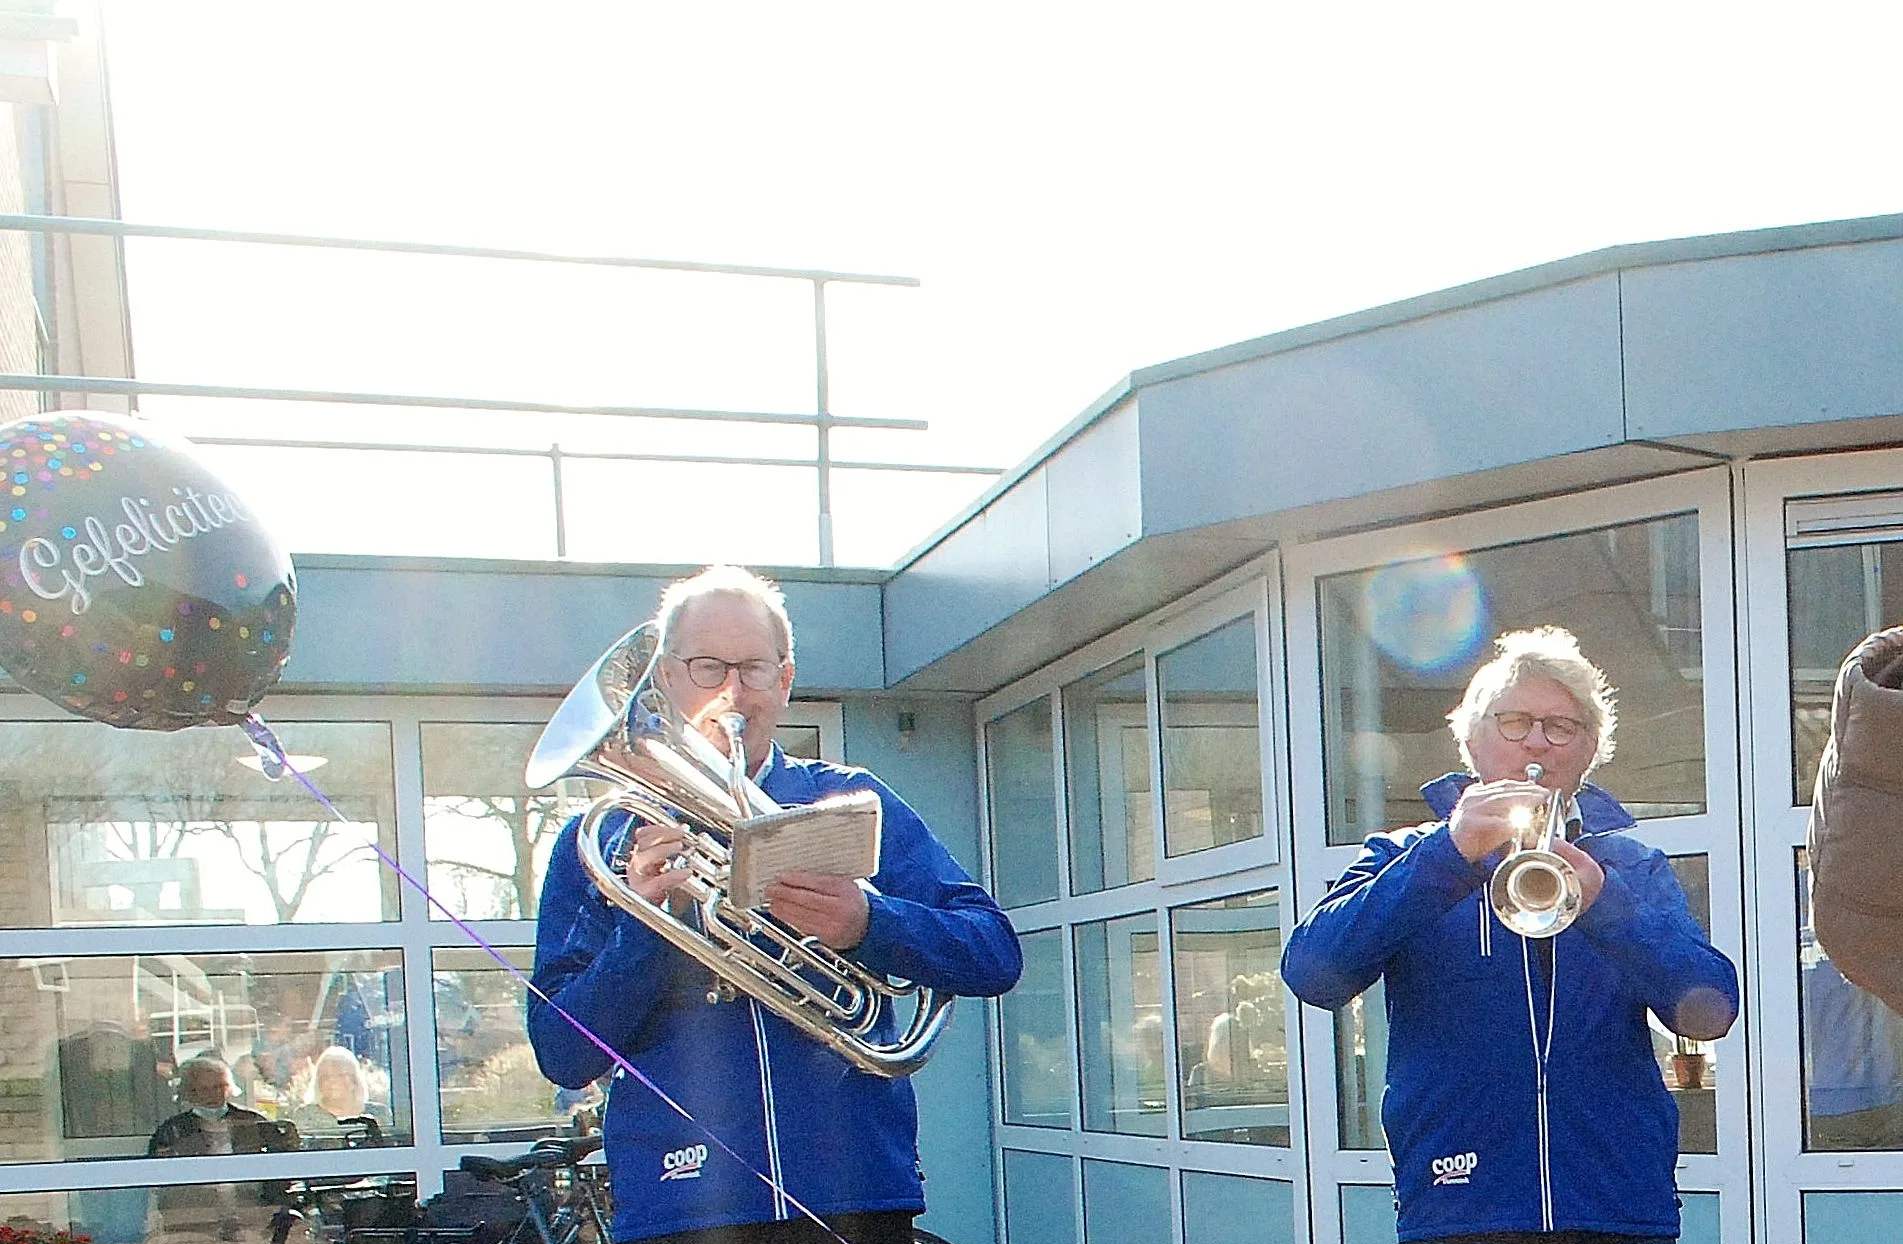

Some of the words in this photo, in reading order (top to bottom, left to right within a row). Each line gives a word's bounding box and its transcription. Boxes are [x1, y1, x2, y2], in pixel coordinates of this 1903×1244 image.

[20, 487, 254, 614] Gefelicitee
[664, 1144, 708, 1169] coop
[1432, 1152, 1478, 1175] coop
